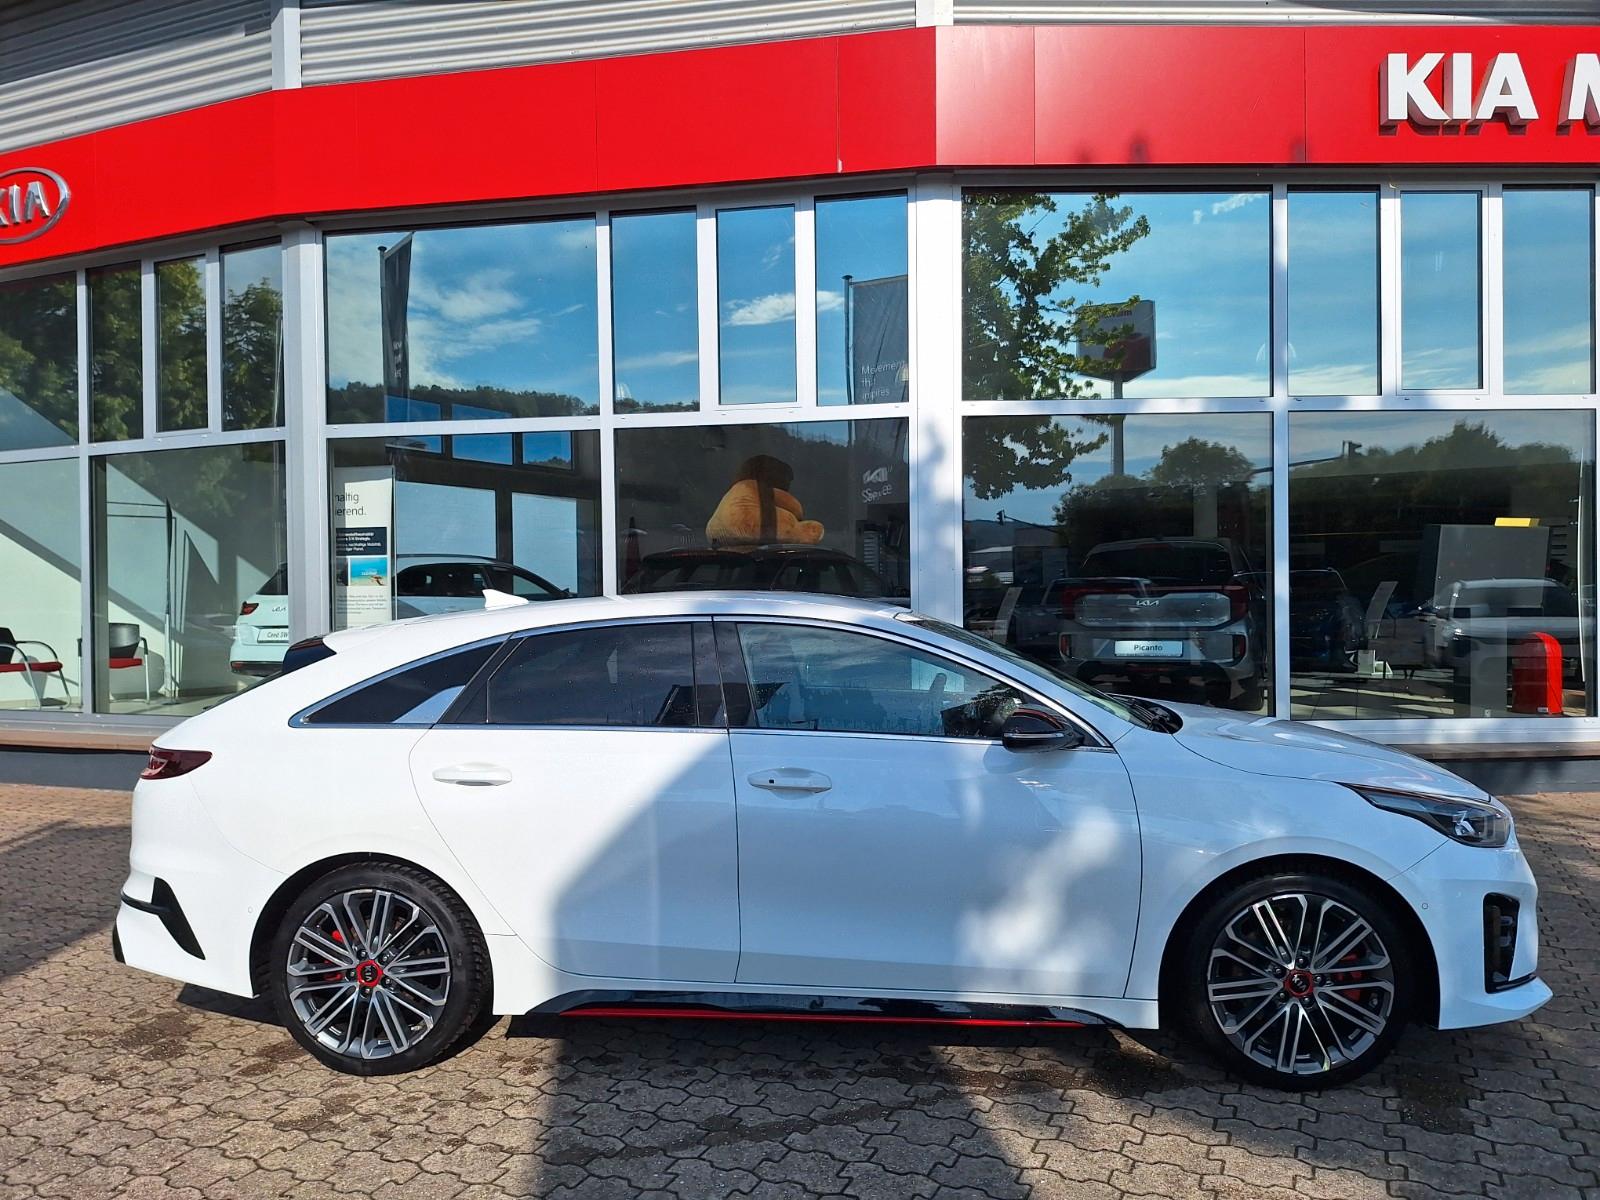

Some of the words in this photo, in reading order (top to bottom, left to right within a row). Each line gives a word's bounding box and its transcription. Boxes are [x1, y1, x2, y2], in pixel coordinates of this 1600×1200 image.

[1382, 52, 1540, 125] KIA
[1136, 599, 1160, 607] KIA
[1134, 644, 1163, 652] Picanto
